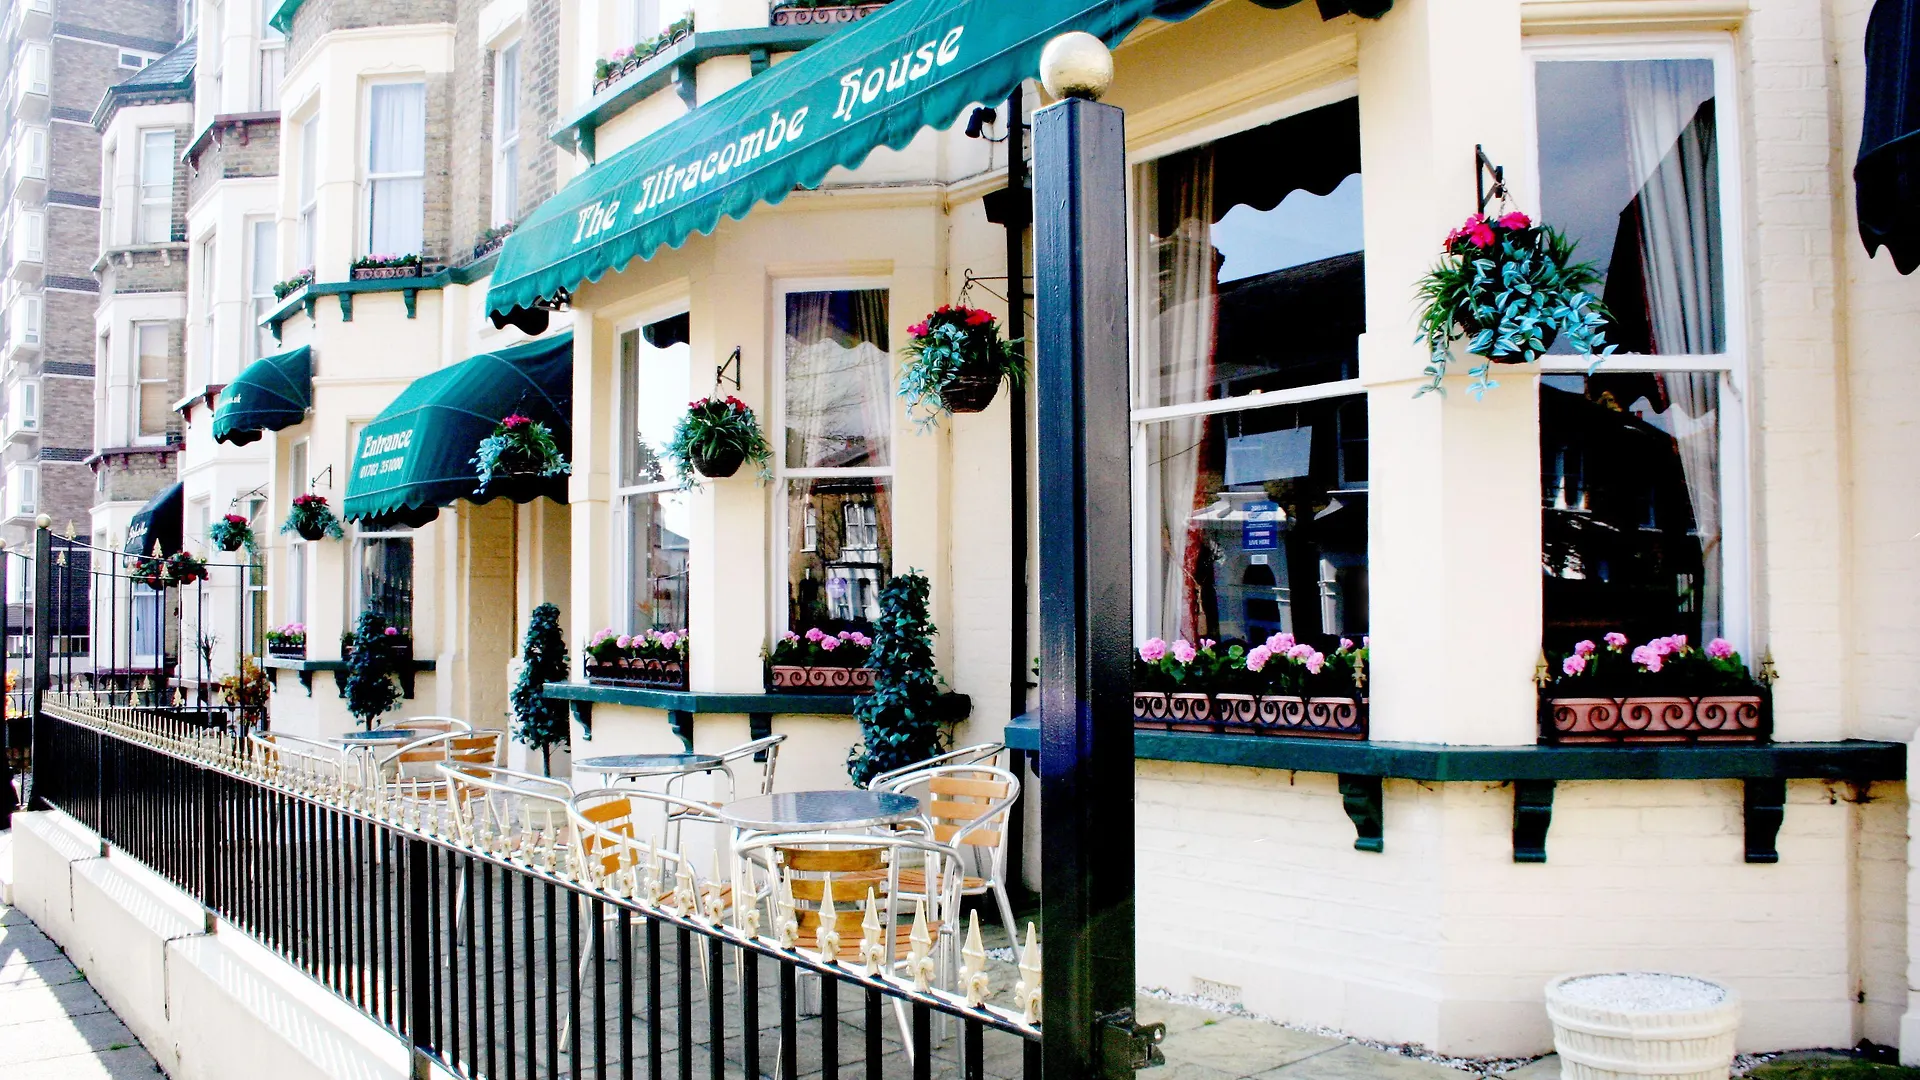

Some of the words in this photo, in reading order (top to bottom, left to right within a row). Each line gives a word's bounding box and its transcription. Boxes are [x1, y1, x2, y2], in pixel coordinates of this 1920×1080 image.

[572, 199, 620, 244] The
[634, 105, 809, 215] Ilfracombe
[832, 25, 965, 121] House
[361, 429, 413, 459] Entrance
